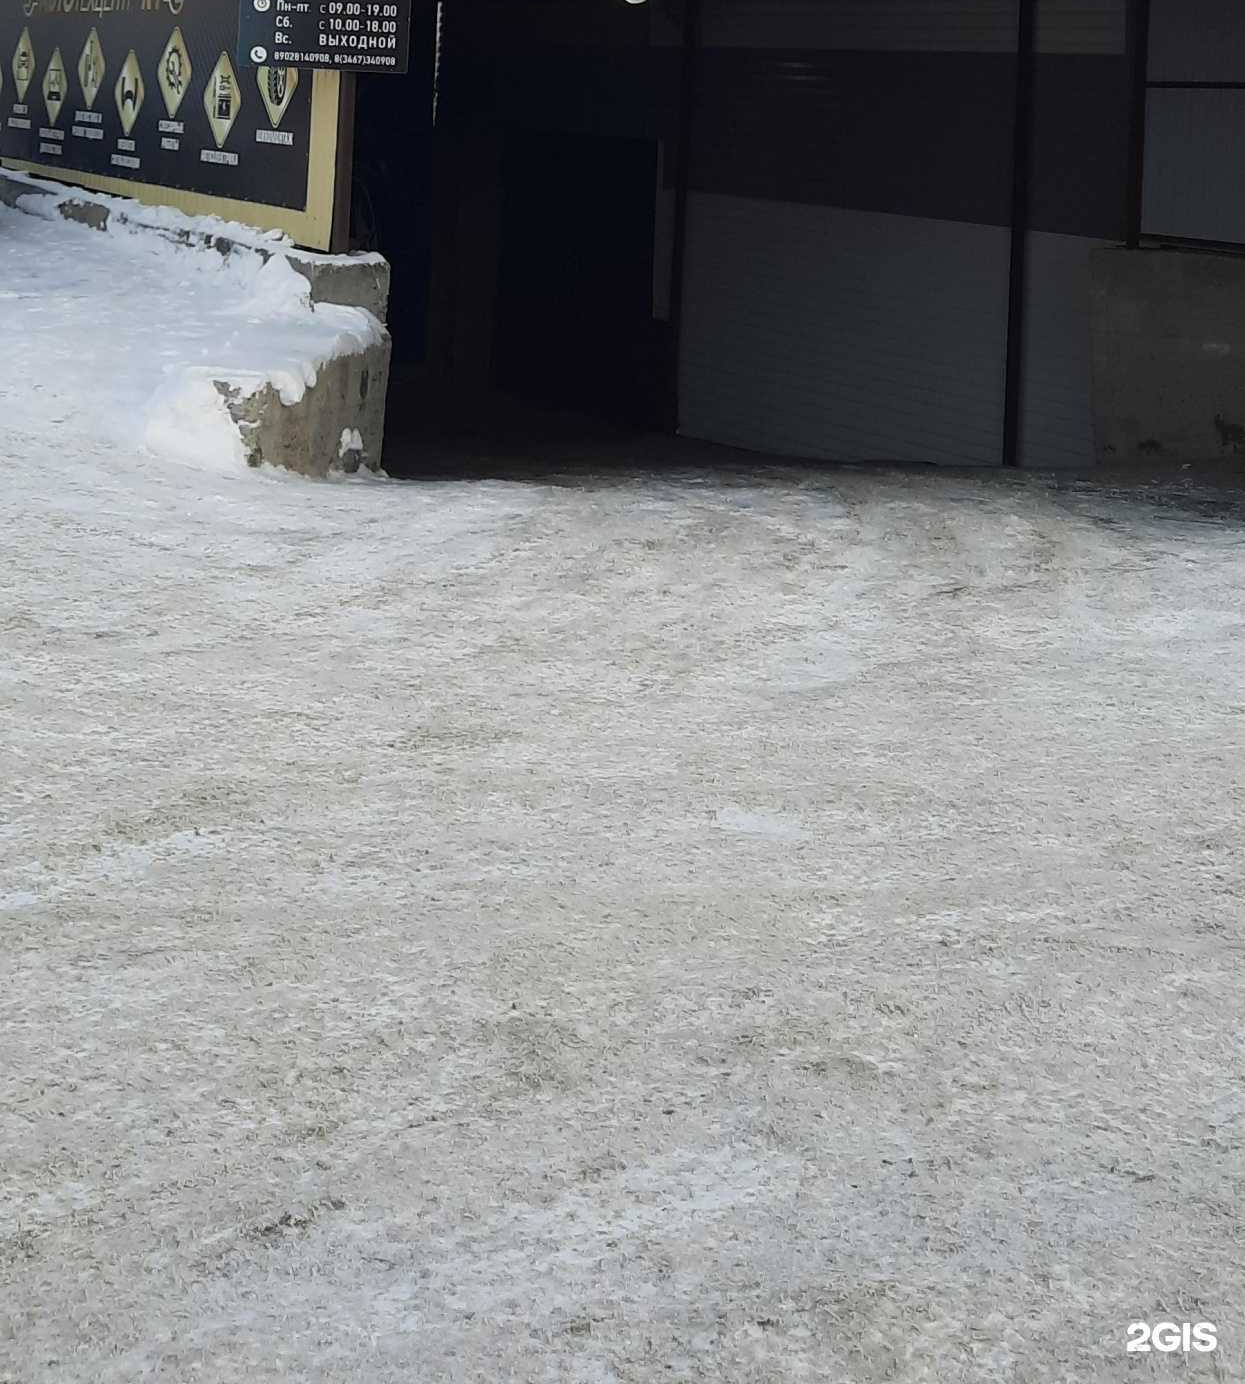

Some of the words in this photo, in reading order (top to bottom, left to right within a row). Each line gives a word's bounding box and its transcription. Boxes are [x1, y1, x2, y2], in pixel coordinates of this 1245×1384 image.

[320, 4, 327, 14] с
[328, 2, 397, 17] 09.00-19.00
[276, 16, 293, 28] Сб.
[319, 21, 326, 30] с
[329, 19, 397, 33] 10.00-18.00
[275, 32, 292, 44] Вс.
[319, 34, 396, 49] ВЫХОДНОЙ
